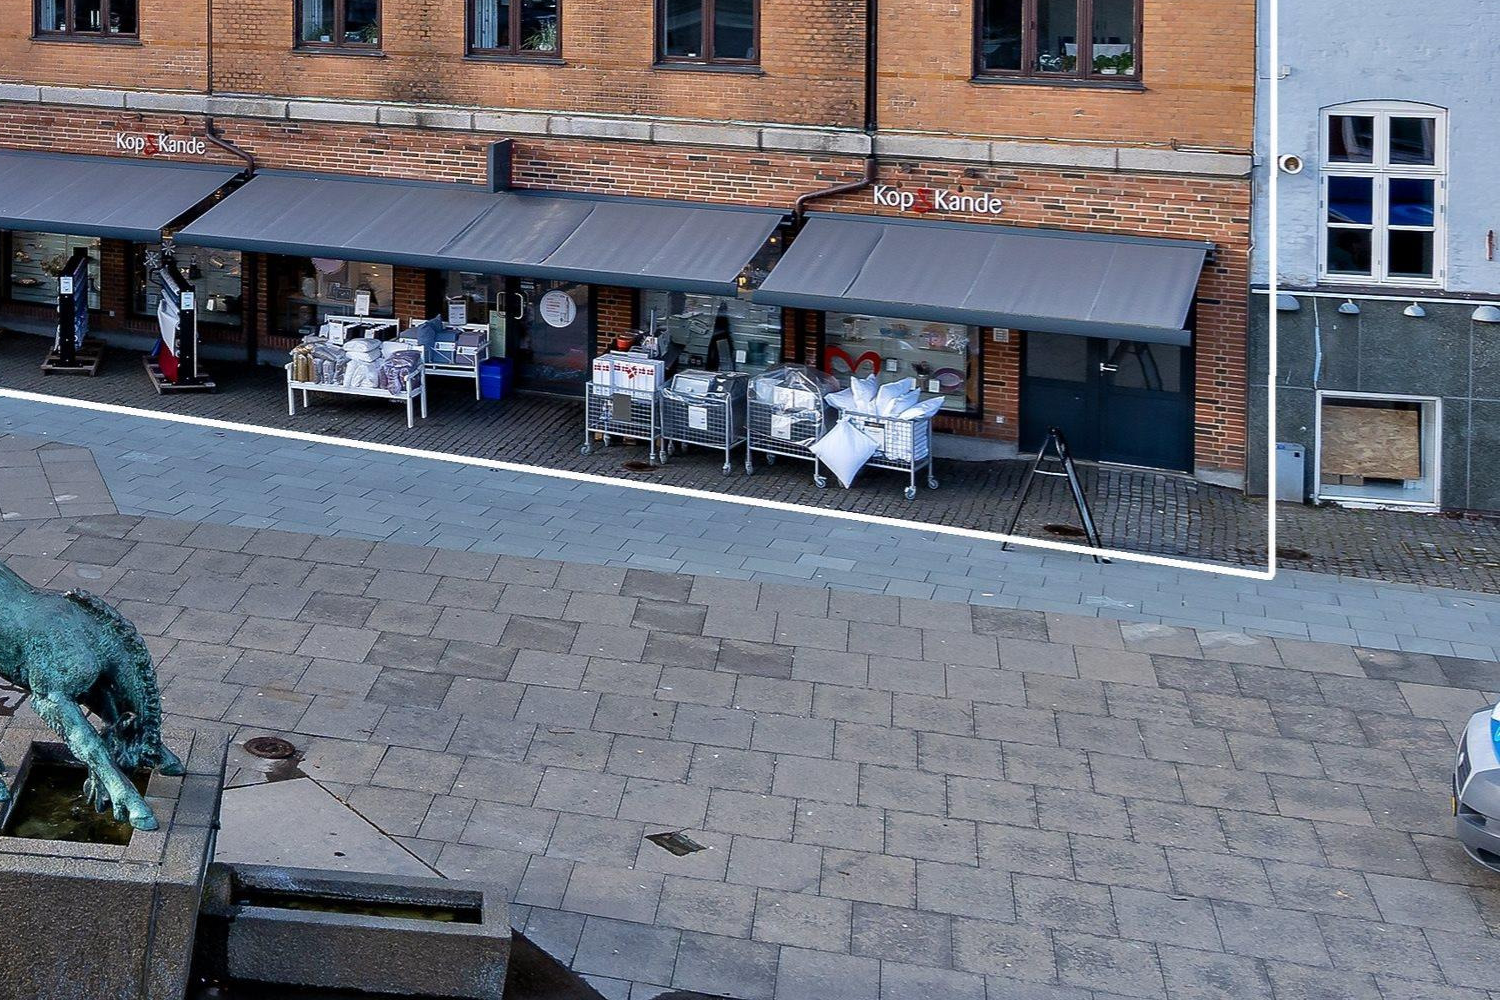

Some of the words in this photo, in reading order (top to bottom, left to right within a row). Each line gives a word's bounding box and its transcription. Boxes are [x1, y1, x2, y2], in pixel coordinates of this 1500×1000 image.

[116, 132, 144, 154] Kop
[159, 134, 205, 154] Kande
[873, 185, 914, 212] Kop
[934, 189, 1002, 214] Kande
